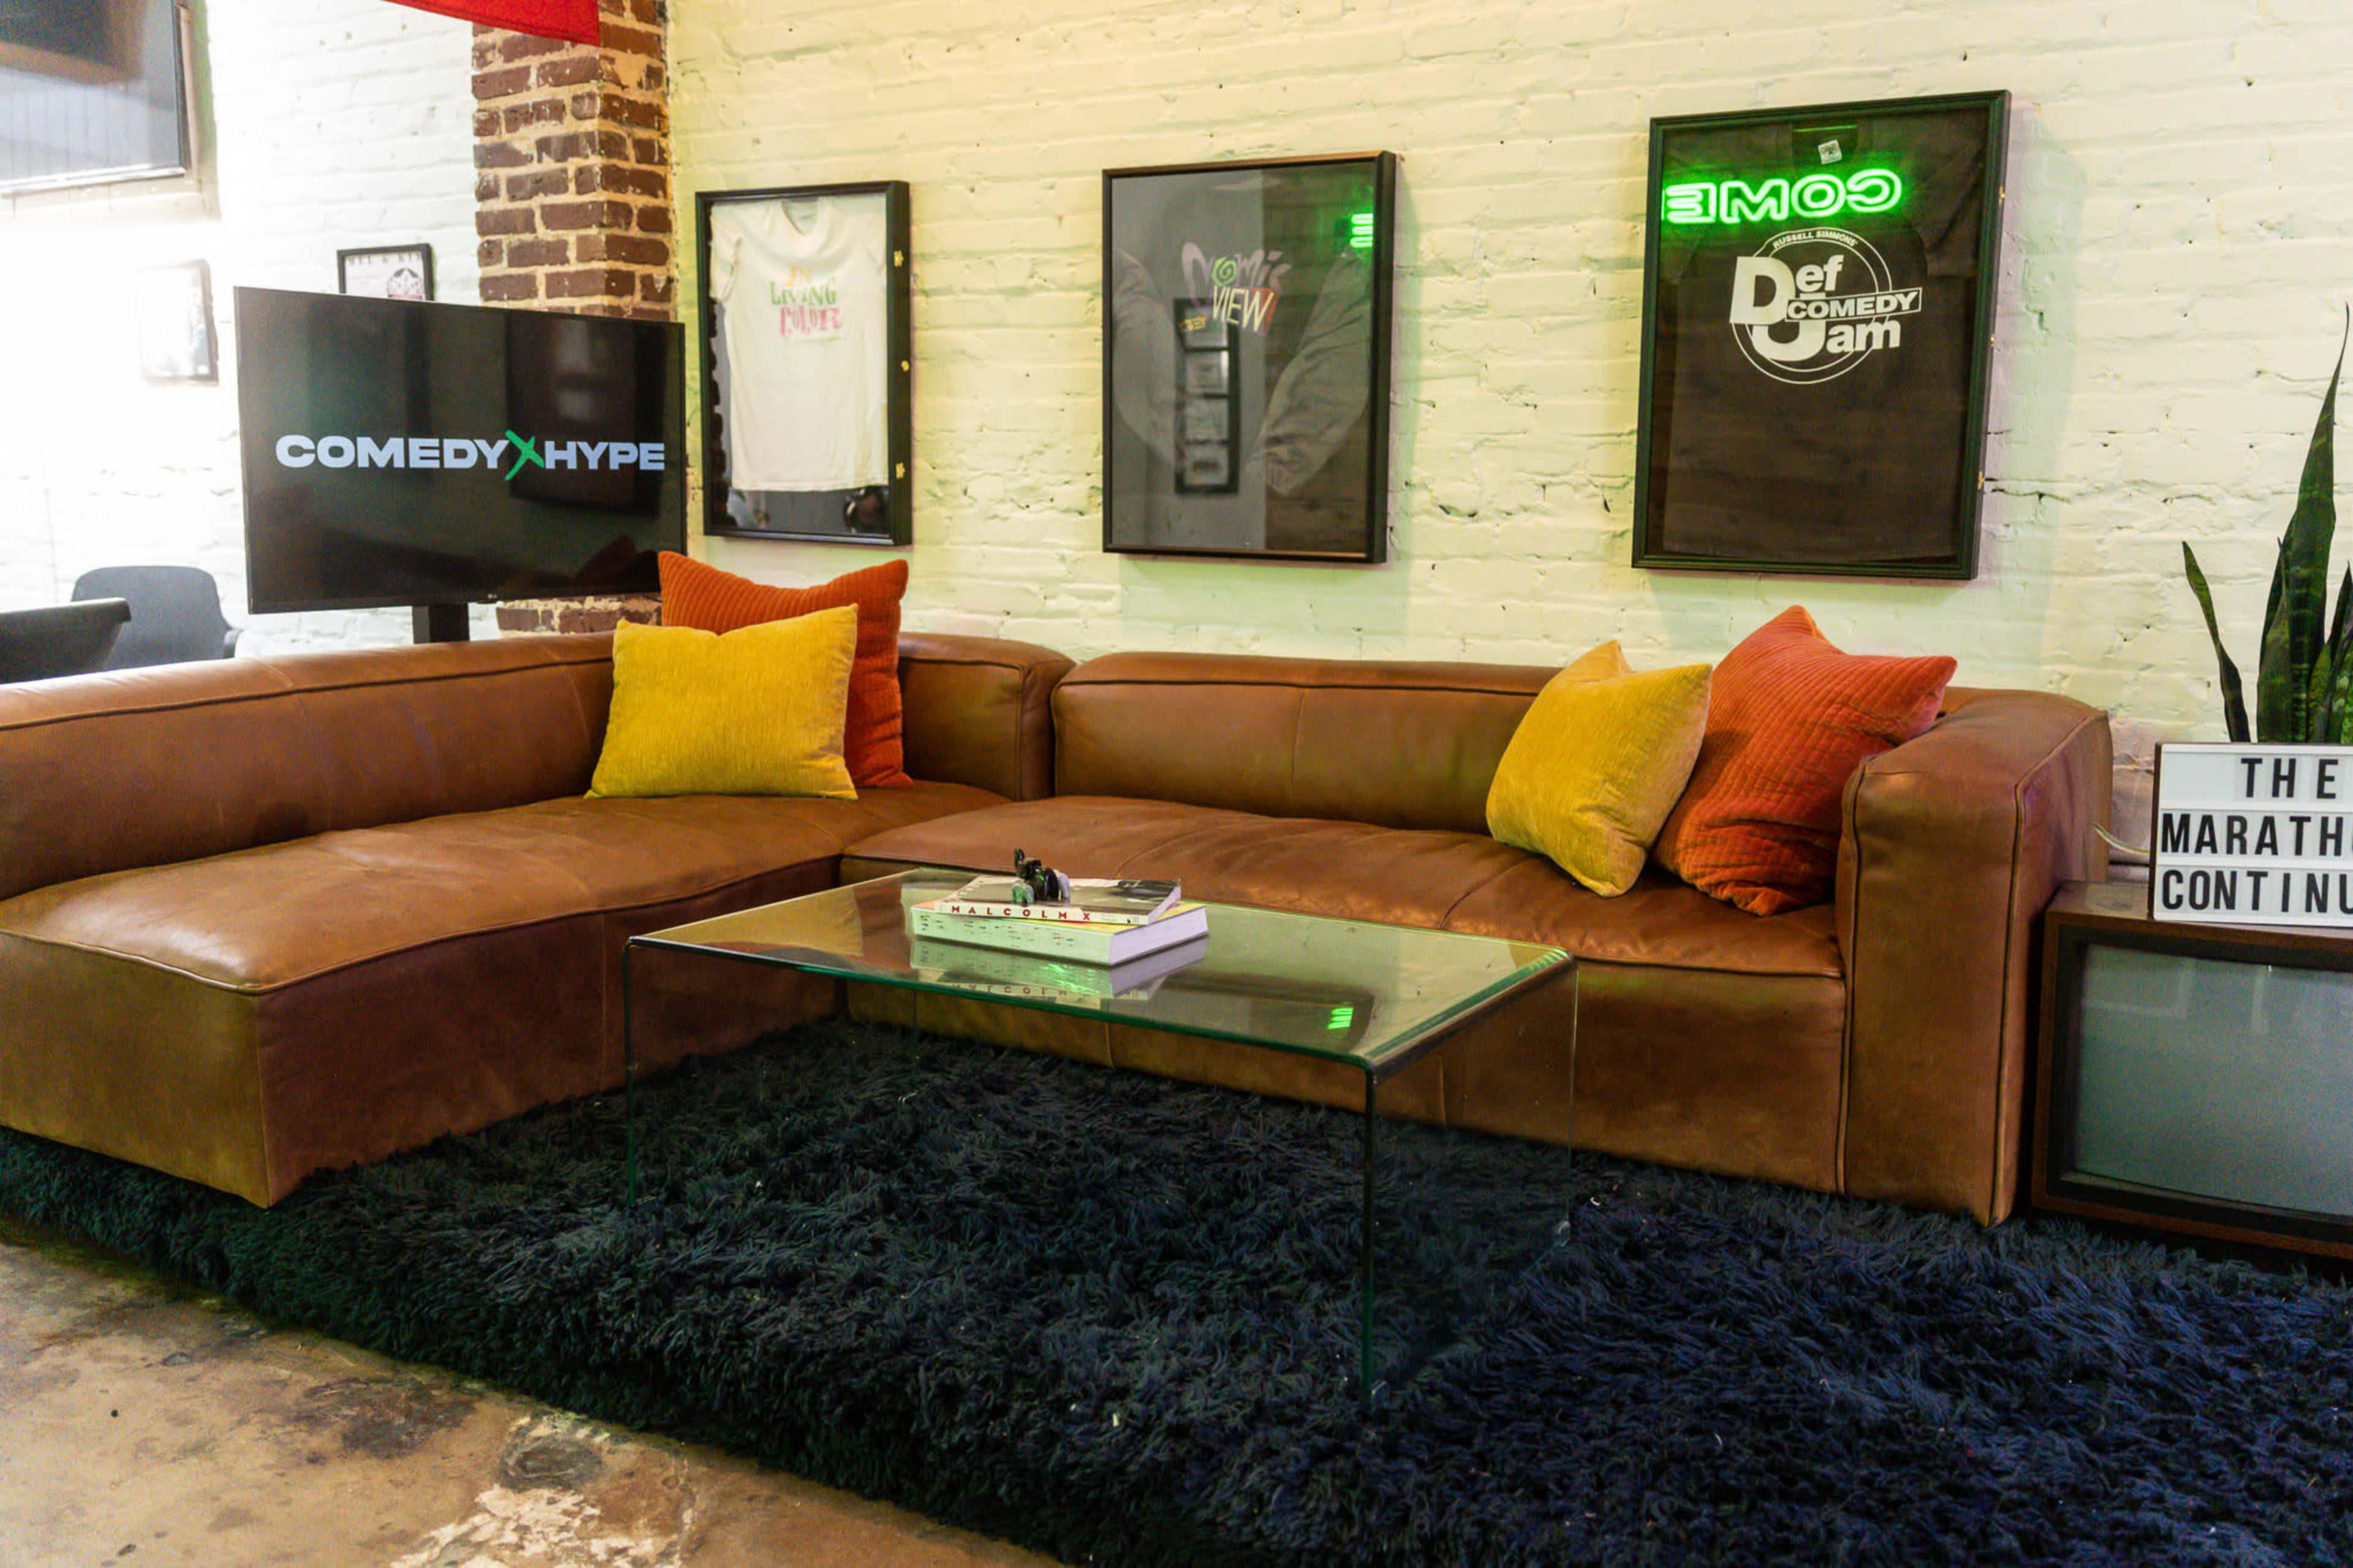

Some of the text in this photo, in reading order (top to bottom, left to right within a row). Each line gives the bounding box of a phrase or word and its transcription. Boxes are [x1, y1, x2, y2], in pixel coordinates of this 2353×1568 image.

[1773, 232, 1814, 249] RUSSELL
[770, 275, 838, 305] LIVING
[784, 263, 813, 286] IN
[1729, 255, 1844, 325] Def
[780, 304, 843, 336] COLOR
[1212, 285, 1275, 332] VIEW
[1787, 291, 1919, 319] COMEDY
[1751, 292, 1901, 362] Jam
[2241, 757, 2339, 800] THE
[2161, 812, 2353, 857] MARATH
[2162, 869, 2353, 915] CONTINU
[951, 906, 1067, 920] MALCOLM
[1082, 912, 1091, 921] X
